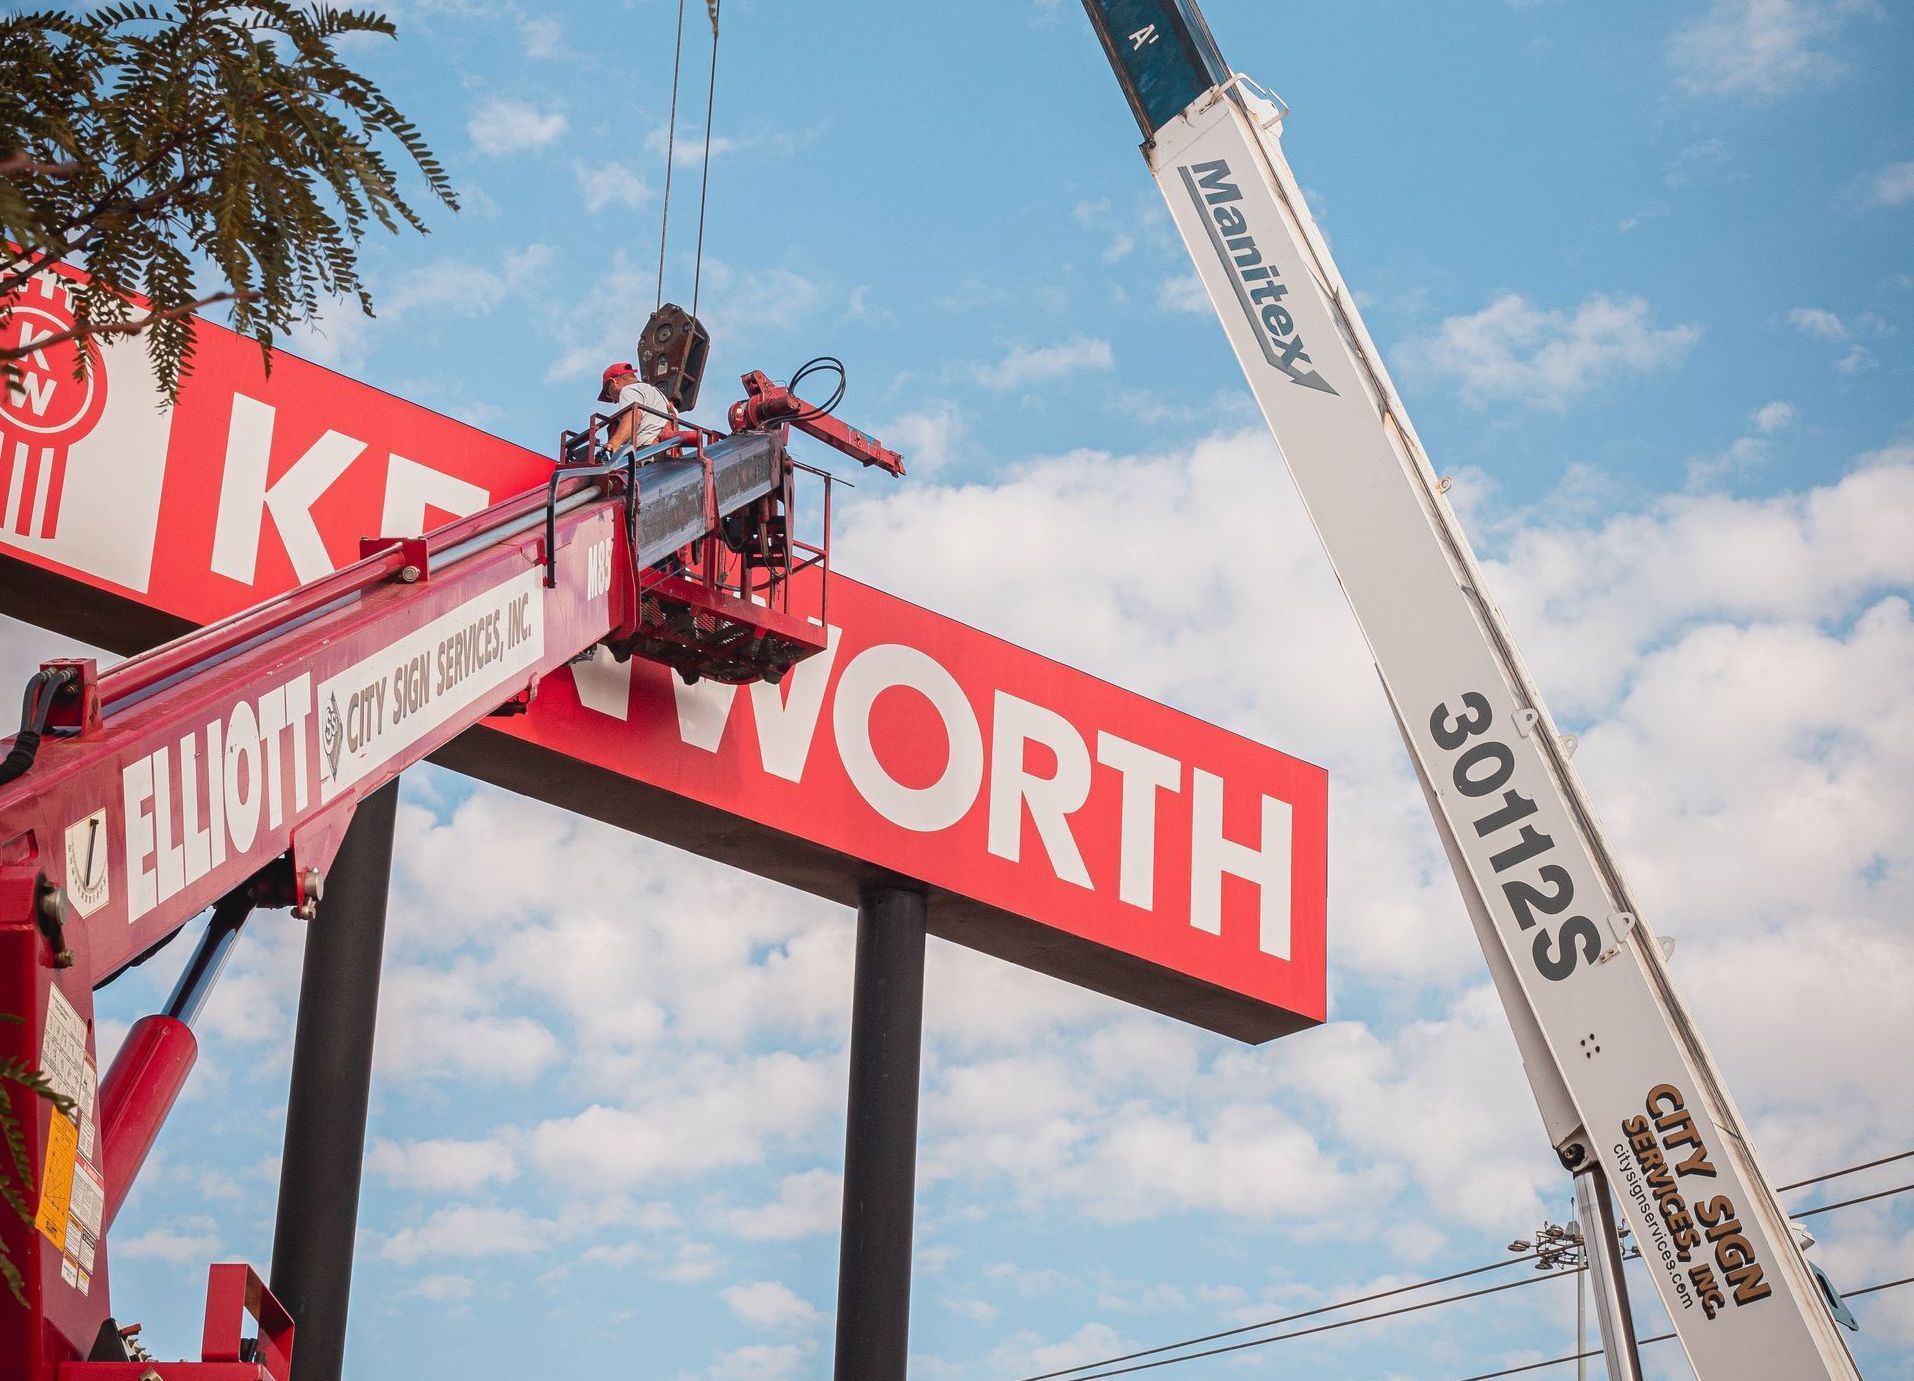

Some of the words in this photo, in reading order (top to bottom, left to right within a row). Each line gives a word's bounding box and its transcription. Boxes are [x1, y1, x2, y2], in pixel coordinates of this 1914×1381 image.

[1190, 158, 1313, 371] Manitex
[346, 676, 388, 754] CITY
[392, 650, 431, 725] SIGN
[436, 608, 504, 697] SERVICES,
[507, 591, 532, 650] INC.
[587, 537, 614, 602] M85
[210, 391, 1293, 962] KWORTH
[122, 671, 312, 925] ELLIOTT
[1429, 691, 1602, 982] 30112S
[1612, 1142, 1694, 1310] citysignservices.com
[1621, 1114, 1702, 1263] SERVICES,
[1687, 1262, 1726, 1321] INC.
[1645, 1083, 1717, 1178] CITY
[1693, 1194, 1772, 1308] SIGN
